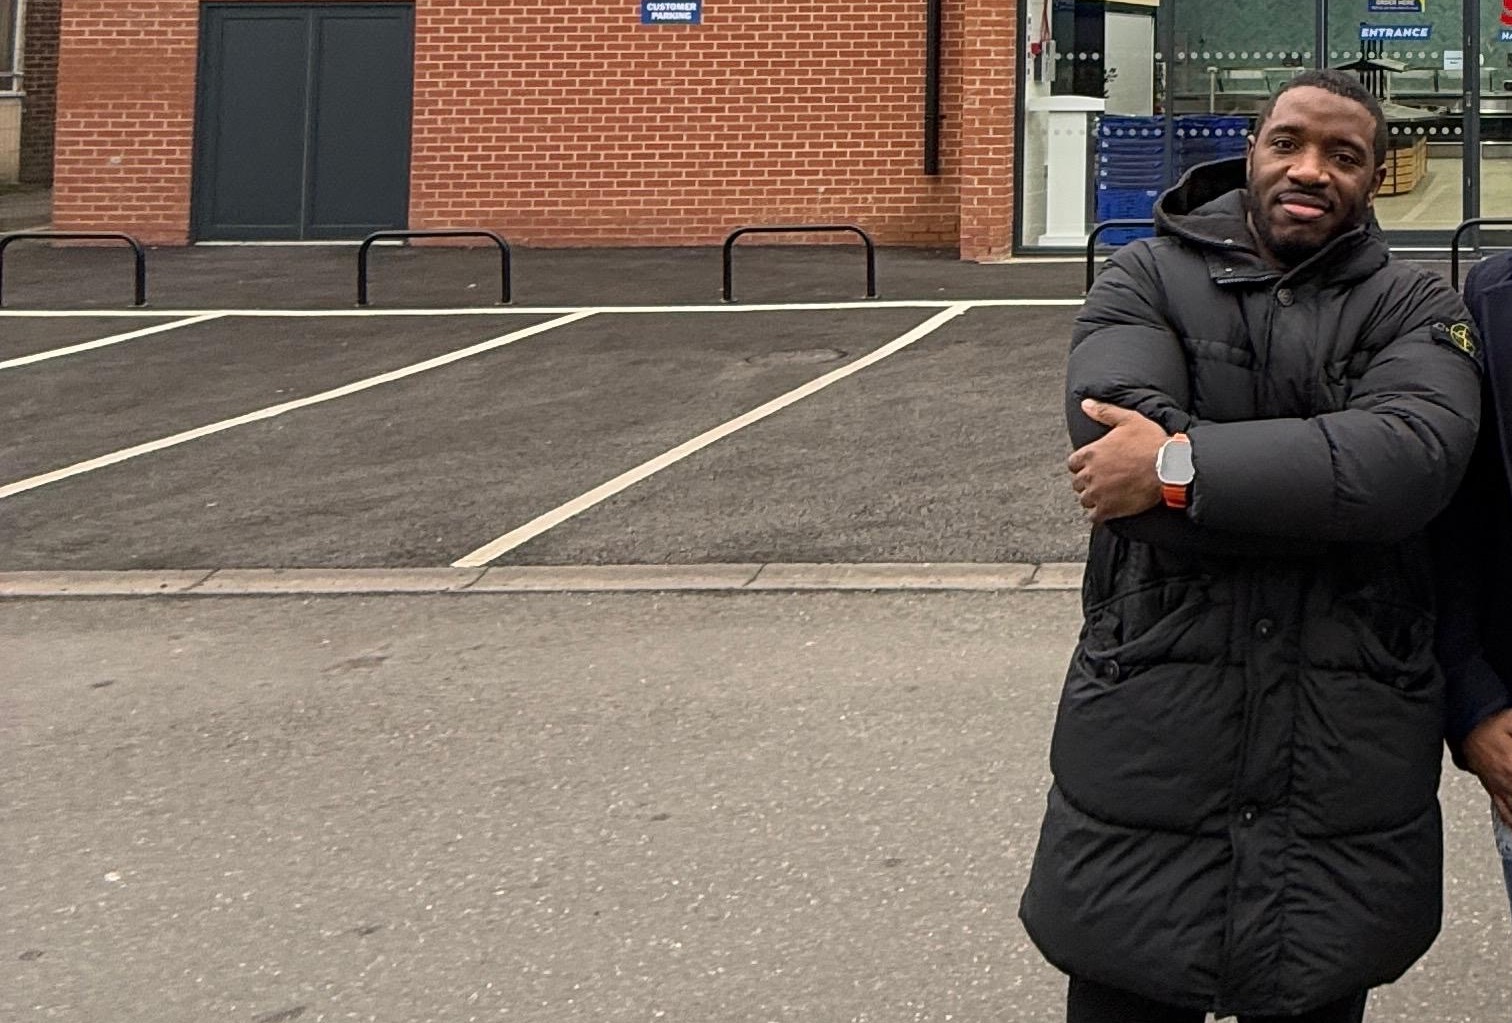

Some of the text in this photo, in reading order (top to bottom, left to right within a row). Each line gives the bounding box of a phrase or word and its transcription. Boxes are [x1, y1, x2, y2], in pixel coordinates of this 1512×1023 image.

[646, 2, 697, 11] CUSTOMER
[651, 12, 692, 20] PARKING
[1361, 28, 1429, 37] ENTRANCE
